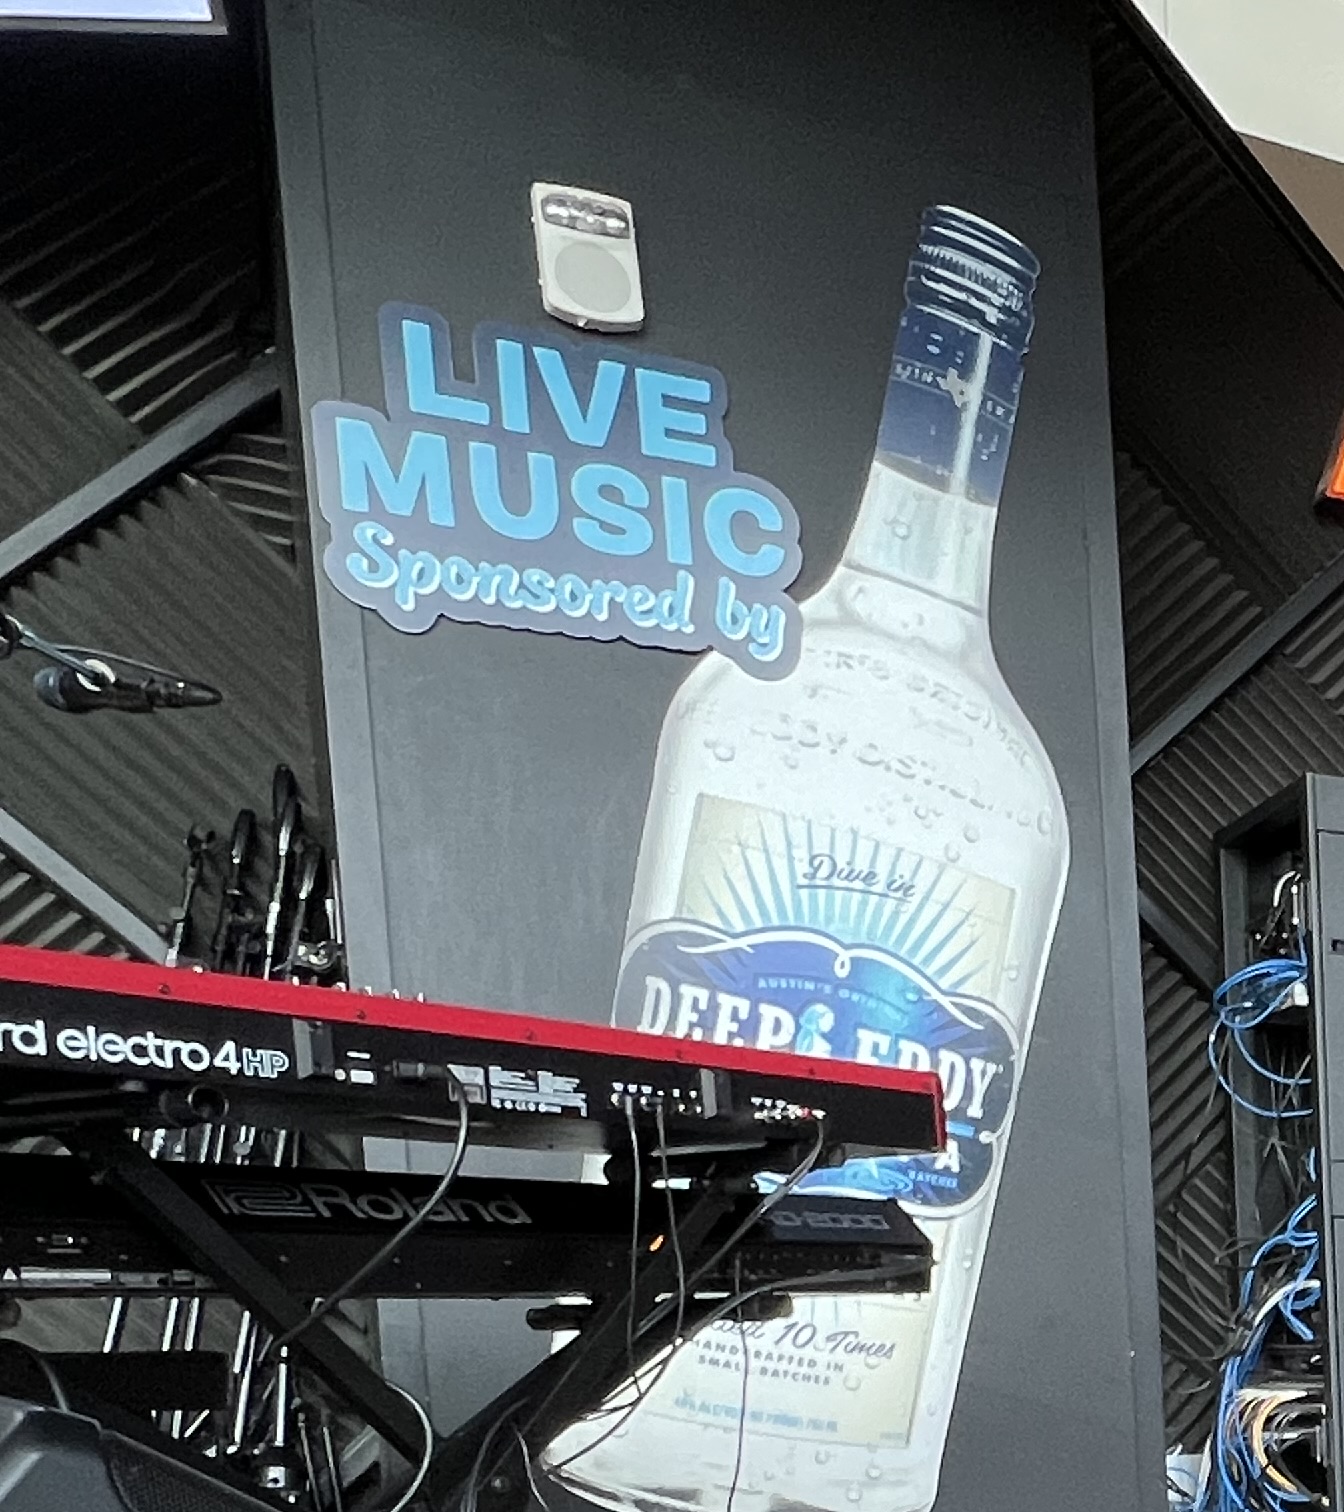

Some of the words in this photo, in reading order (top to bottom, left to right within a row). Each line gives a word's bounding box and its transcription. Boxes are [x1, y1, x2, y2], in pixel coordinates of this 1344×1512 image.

[401, 318, 718, 468] LIVE
[334, 416, 785, 577] MUSIC
[345, 521, 696, 636] Sponsored
[715, 580, 785, 663] by
[802, 852, 879, 887] Dive
[886, 877, 917, 898] in
[637, 975, 797, 1054] DEEP
[299, 1181, 534, 1226] Roland
[693, 1339, 818, 1371] HANDRAFTED
[826, 1361, 845, 1375] IN
[697, 1354, 747, 1373] SMAL
[772, 1321, 816, 1352] 10
[825, 1329, 898, 1361] Times
